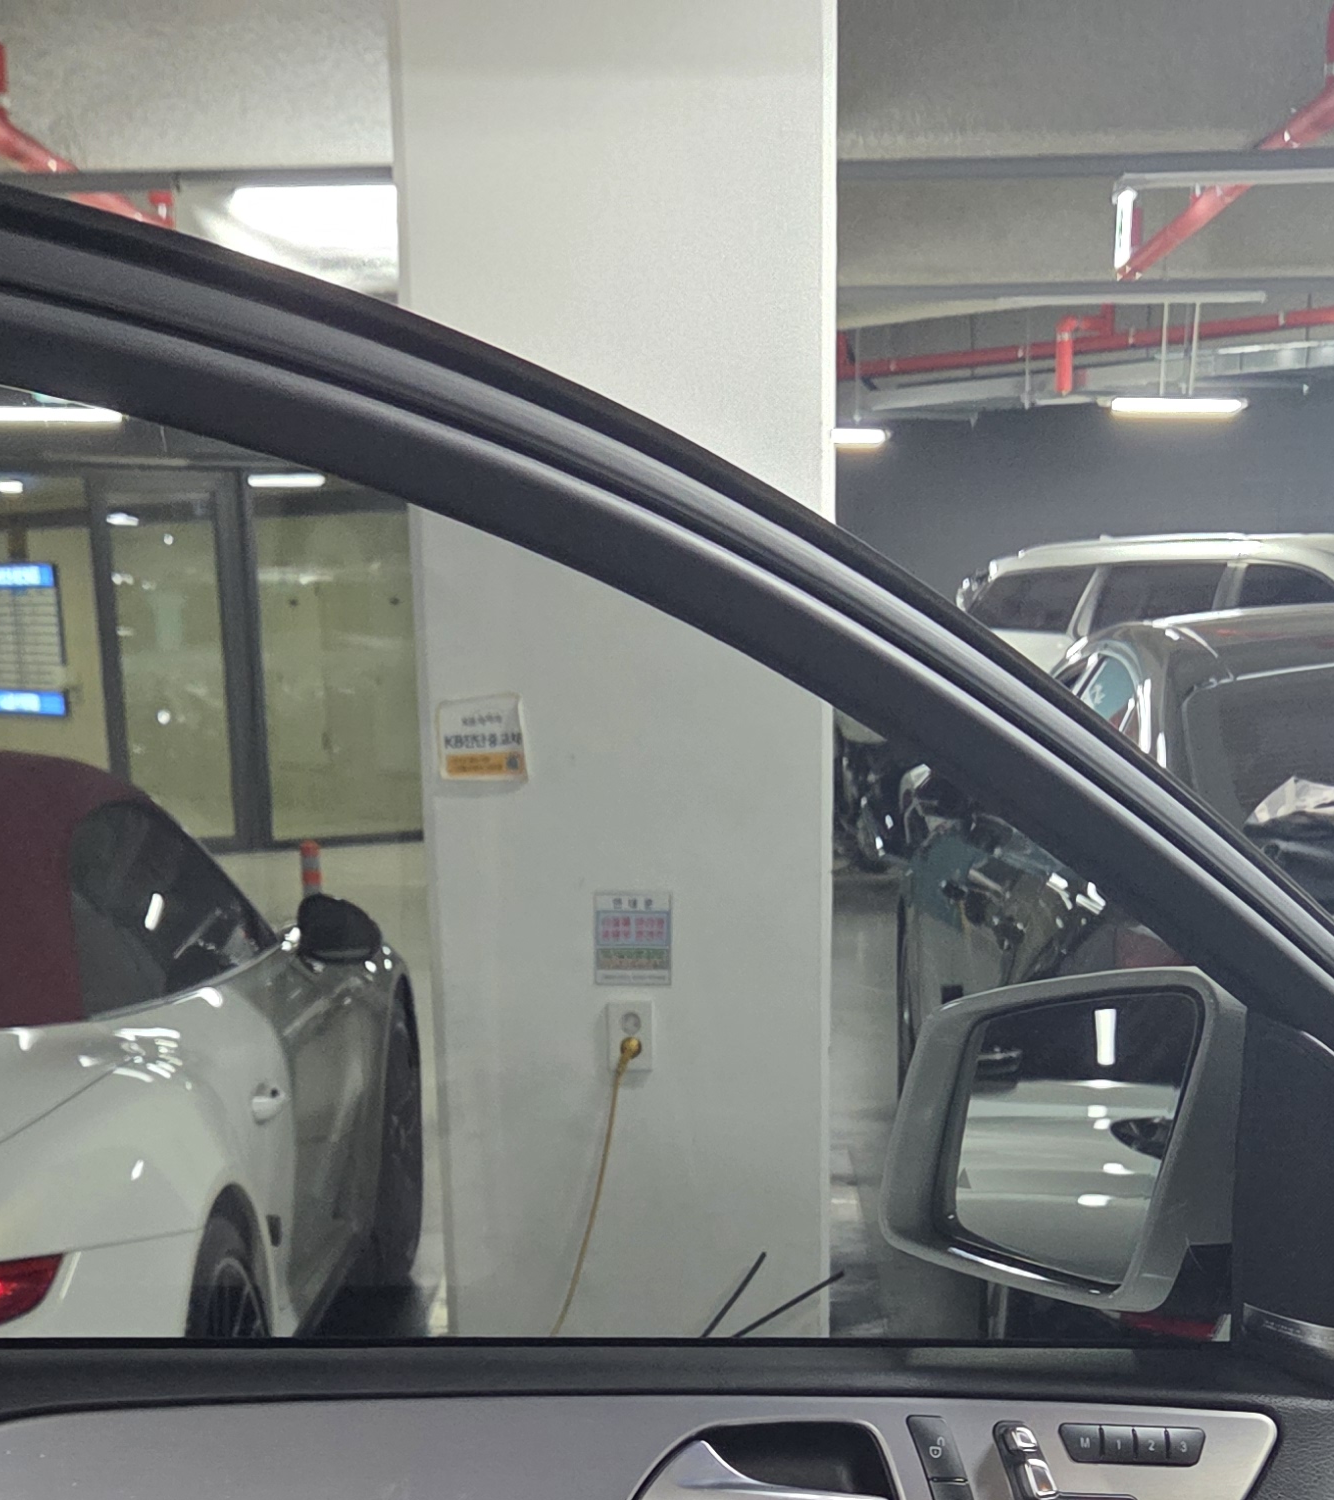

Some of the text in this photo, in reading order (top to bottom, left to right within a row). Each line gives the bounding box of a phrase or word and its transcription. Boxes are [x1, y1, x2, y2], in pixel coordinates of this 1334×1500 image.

[1080, 1437, 1188, 1453] M 1 2 3
